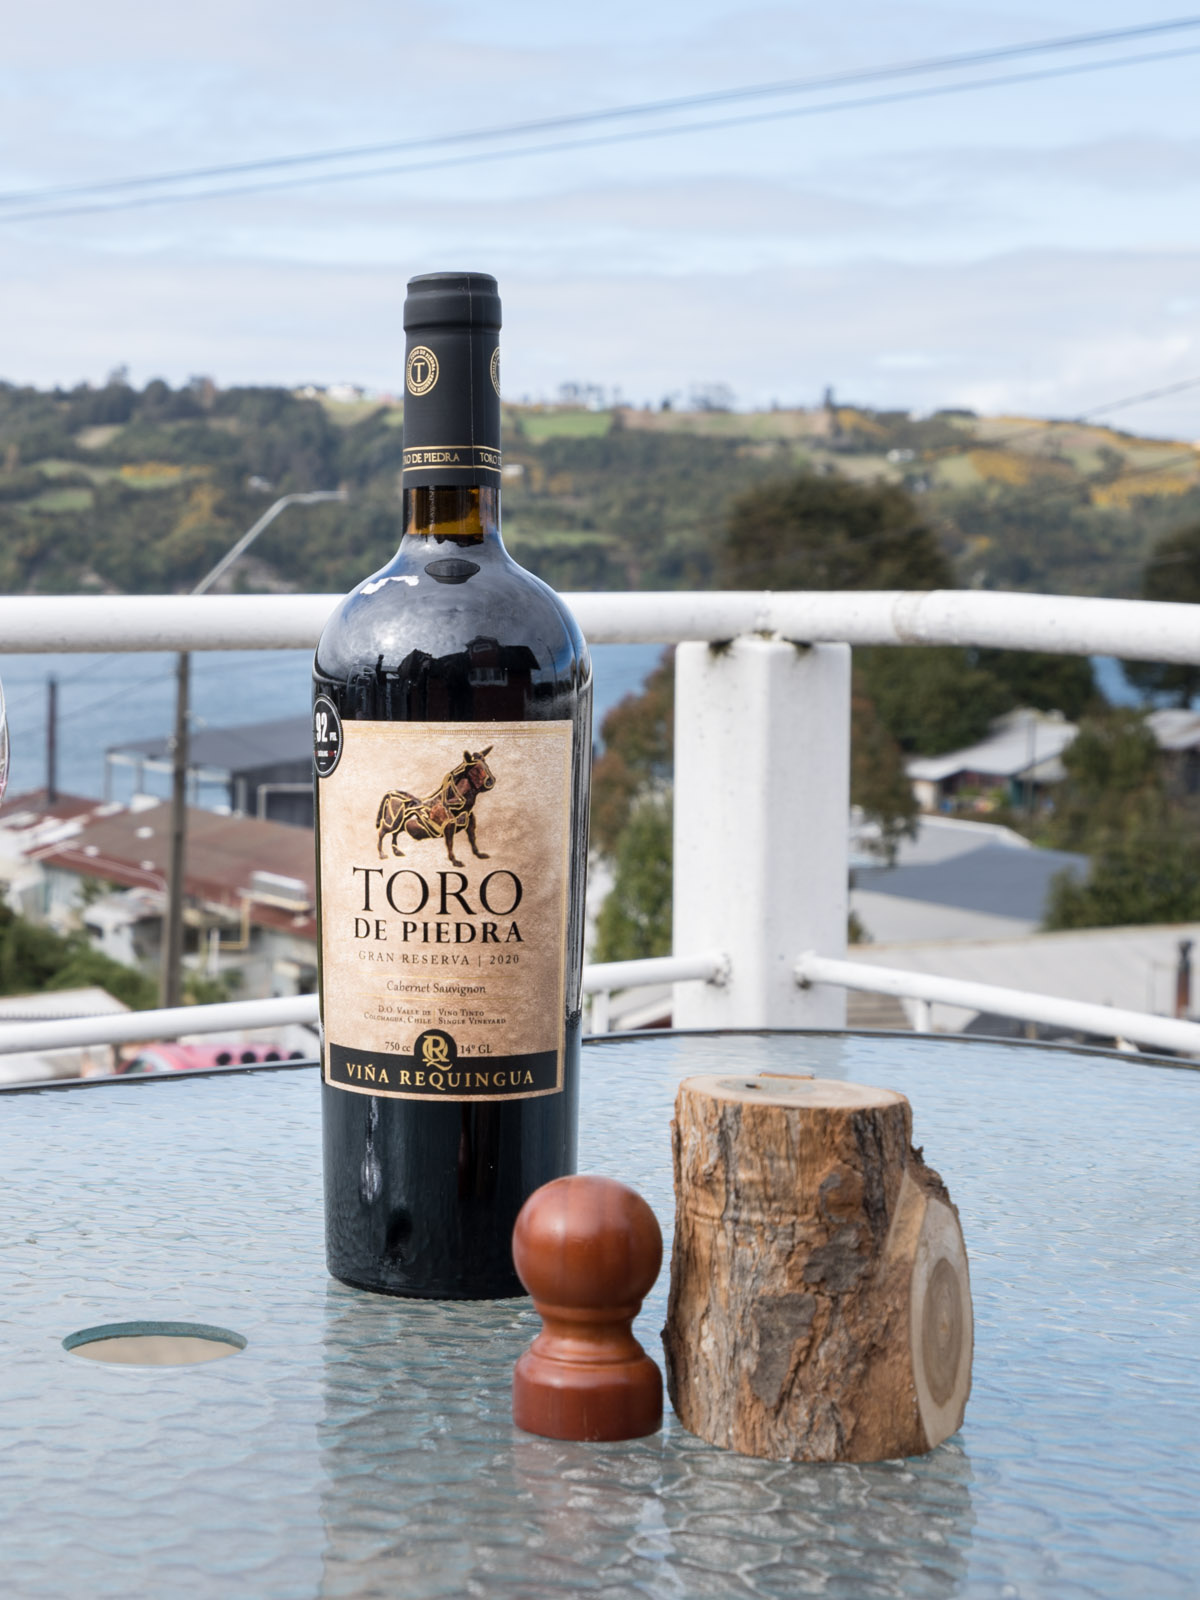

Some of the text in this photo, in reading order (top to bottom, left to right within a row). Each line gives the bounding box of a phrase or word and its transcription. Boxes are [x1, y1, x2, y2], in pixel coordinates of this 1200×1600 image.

[413, 361, 426, 383] T
[411, 453, 423, 464] DE
[423, 452, 460, 463] PIEDRA
[479, 452, 498, 465] TORO
[315, 711, 328, 743] 92
[352, 866, 523, 916] TORO
[354, 917, 525, 944] DE PIEDRA
[358, 950, 520, 966] GRAN RESERVA 2020
[386, 980, 487, 997] Cabernet Sauvignon
[384, 1041, 401, 1052] 750
[478, 1043, 493, 1054] GL
[345, 1062, 535, 1092] VIÑA REQUINGUA
